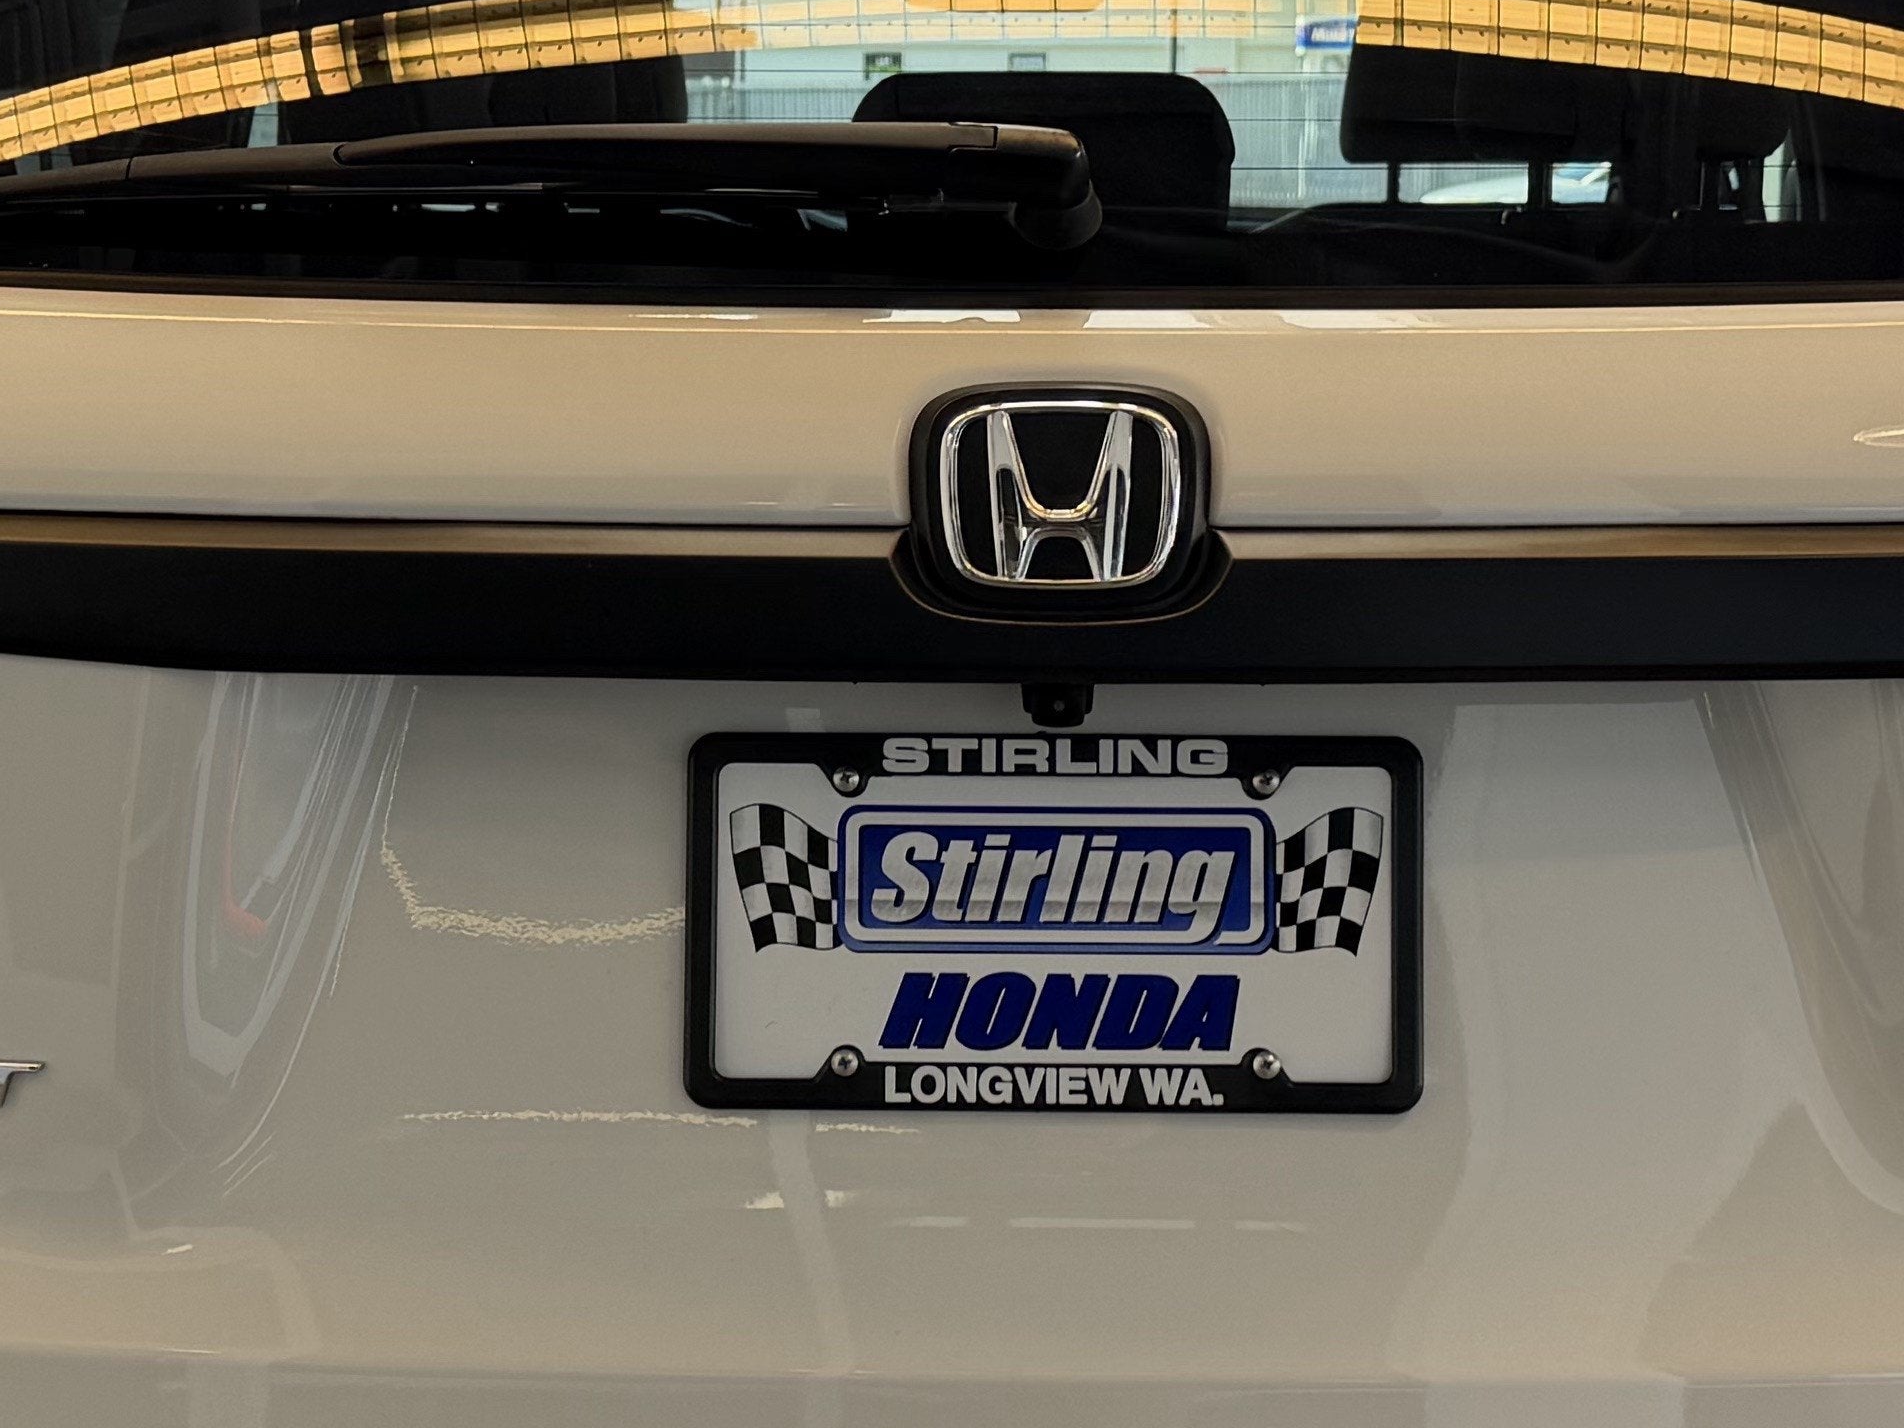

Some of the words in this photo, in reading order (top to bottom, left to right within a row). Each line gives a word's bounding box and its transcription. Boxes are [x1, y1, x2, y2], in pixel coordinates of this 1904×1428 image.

[881, 737, 1230, 775] STIRLING
[869, 830, 1235, 945] Stirling
[878, 971, 1241, 1052] HONDA
[883, 1065, 1136, 1106] LONGVIEW
[1139, 1068, 1225, 1106] WA.
